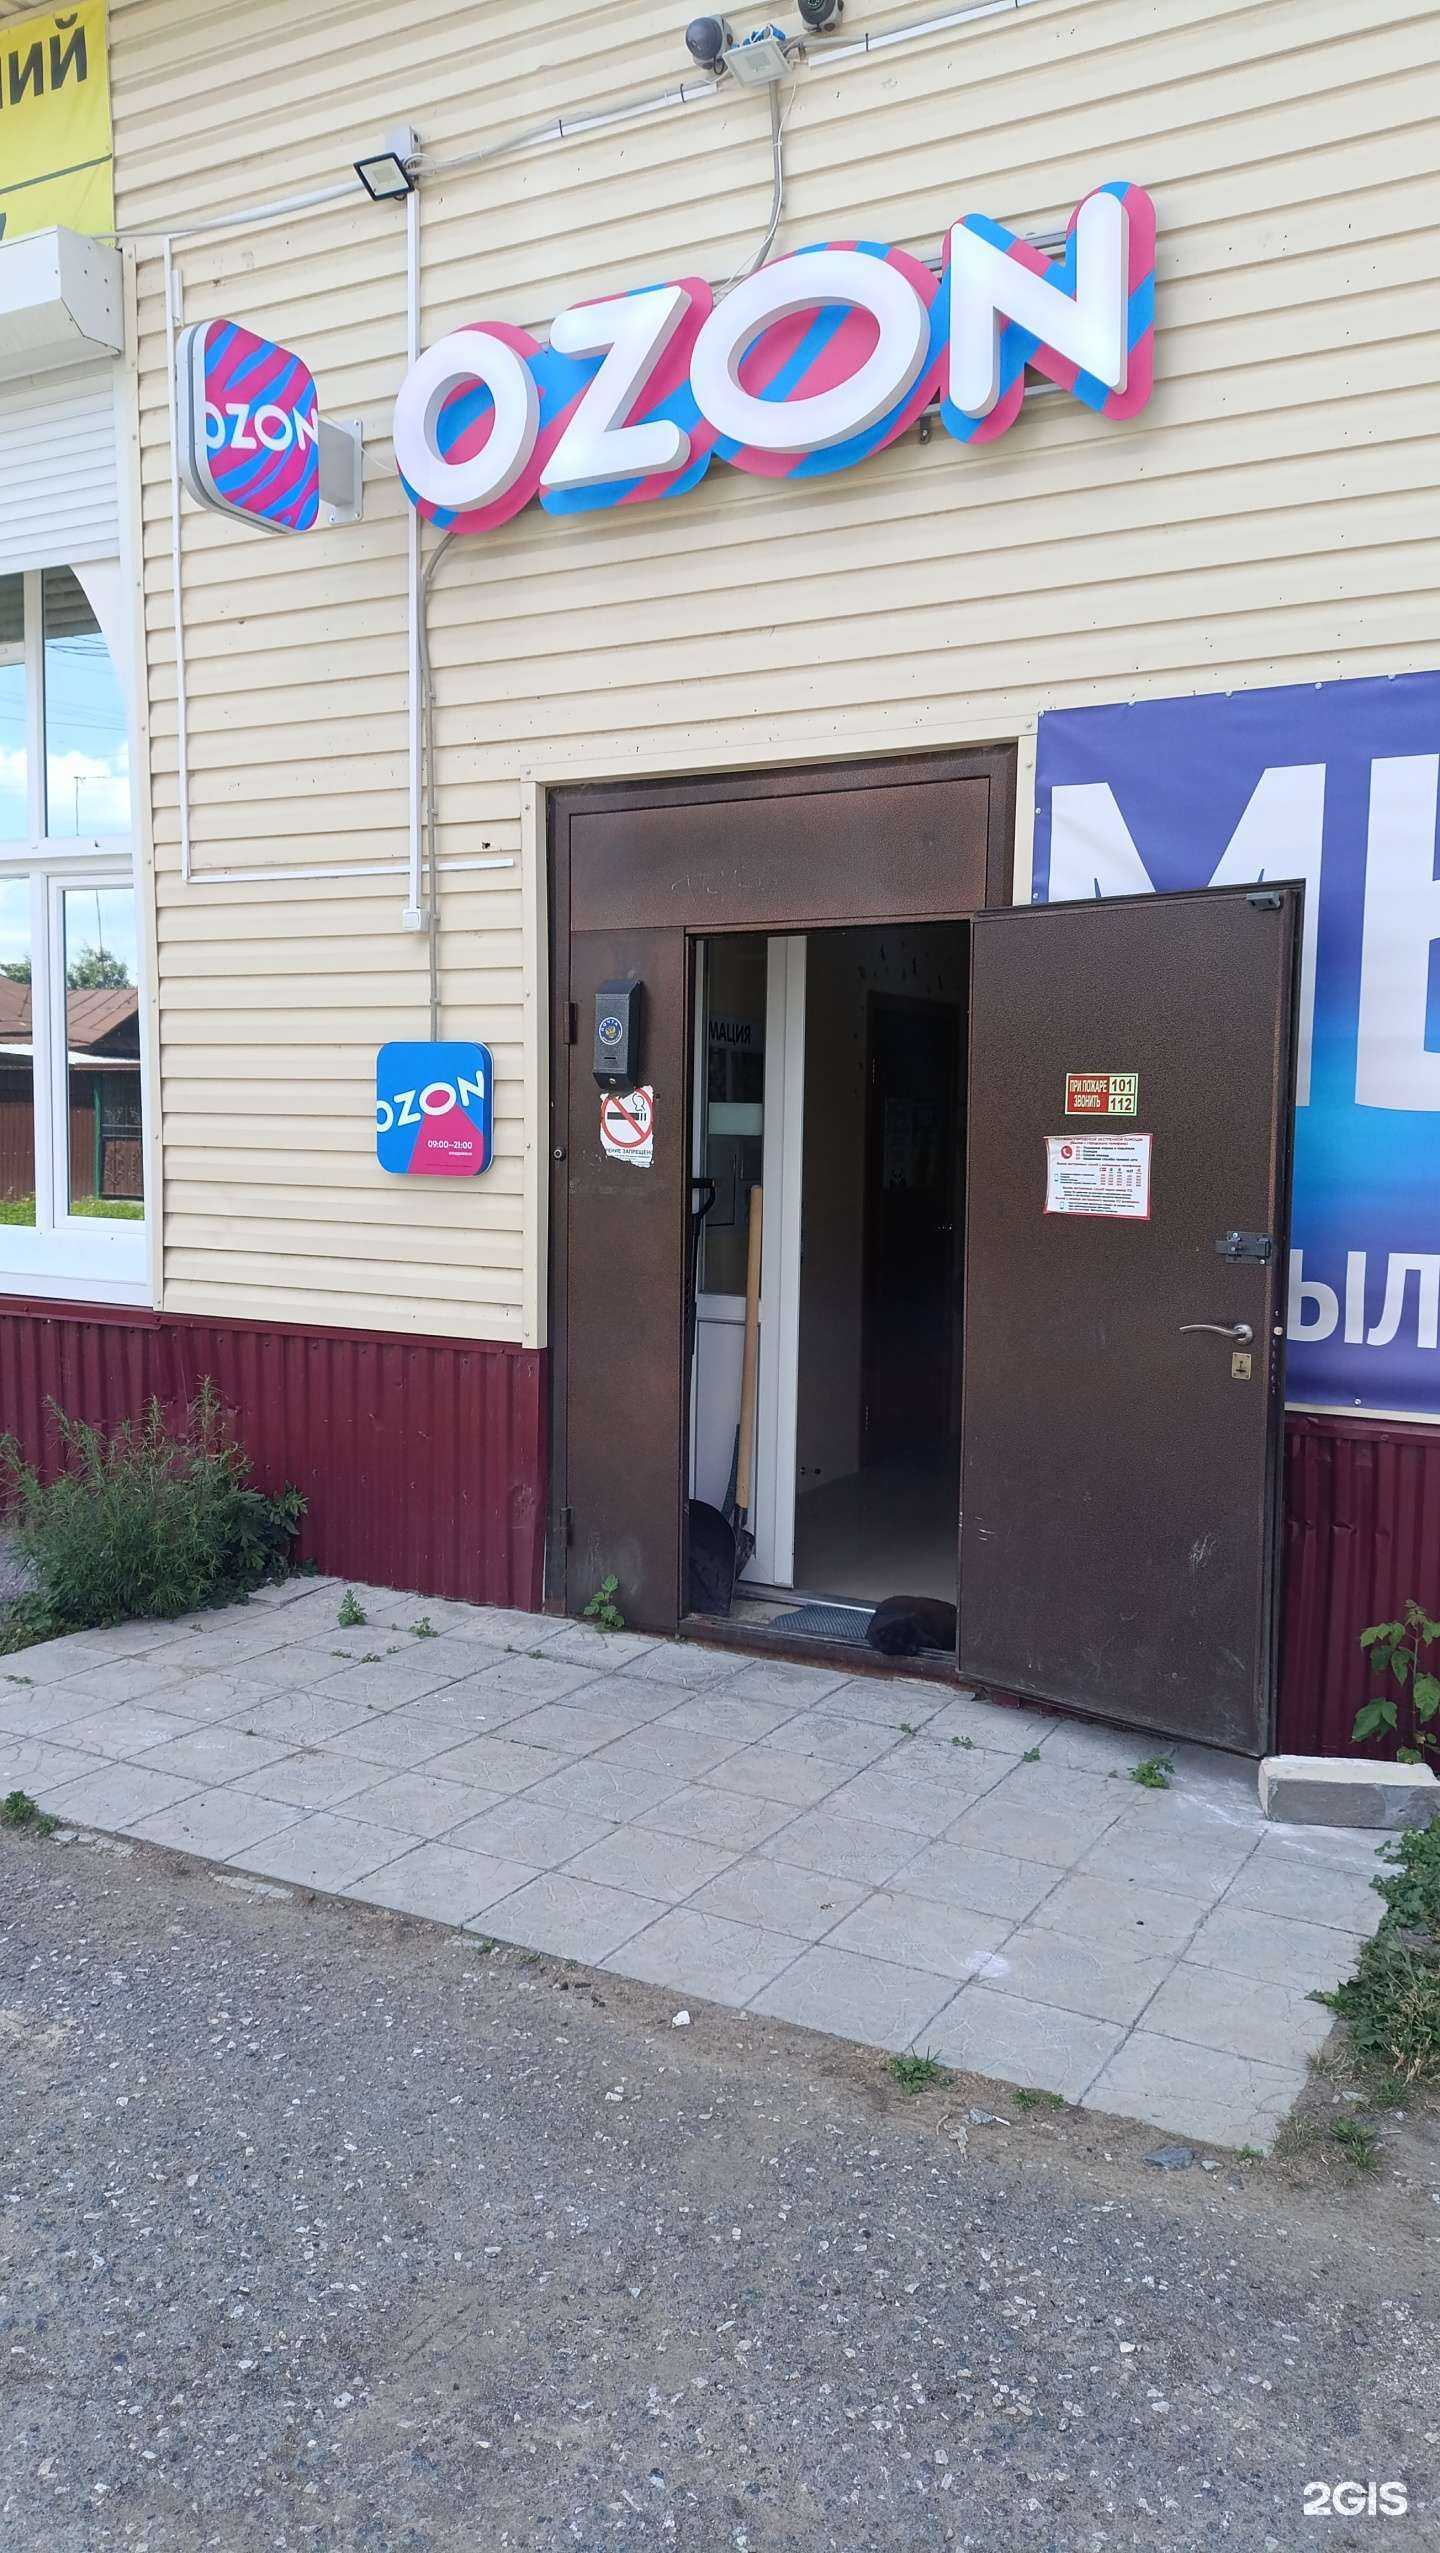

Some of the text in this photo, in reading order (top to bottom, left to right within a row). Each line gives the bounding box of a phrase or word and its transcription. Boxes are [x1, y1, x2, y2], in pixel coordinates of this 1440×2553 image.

[0, 12, 88, 109] ИЙ
[394, 191, 1129, 511] OZON
[204, 400, 318, 451] OZON
[376, 1070, 485, 1132] OZON
[1070, 1080, 1107, 1093] ПРИ ПОЖАРЕ
[1074, 1095, 1101, 1108] ЗВОНИТЬ
[1112, 1079, 1132, 1092] 101
[1111, 1098, 1132, 1111] 112
